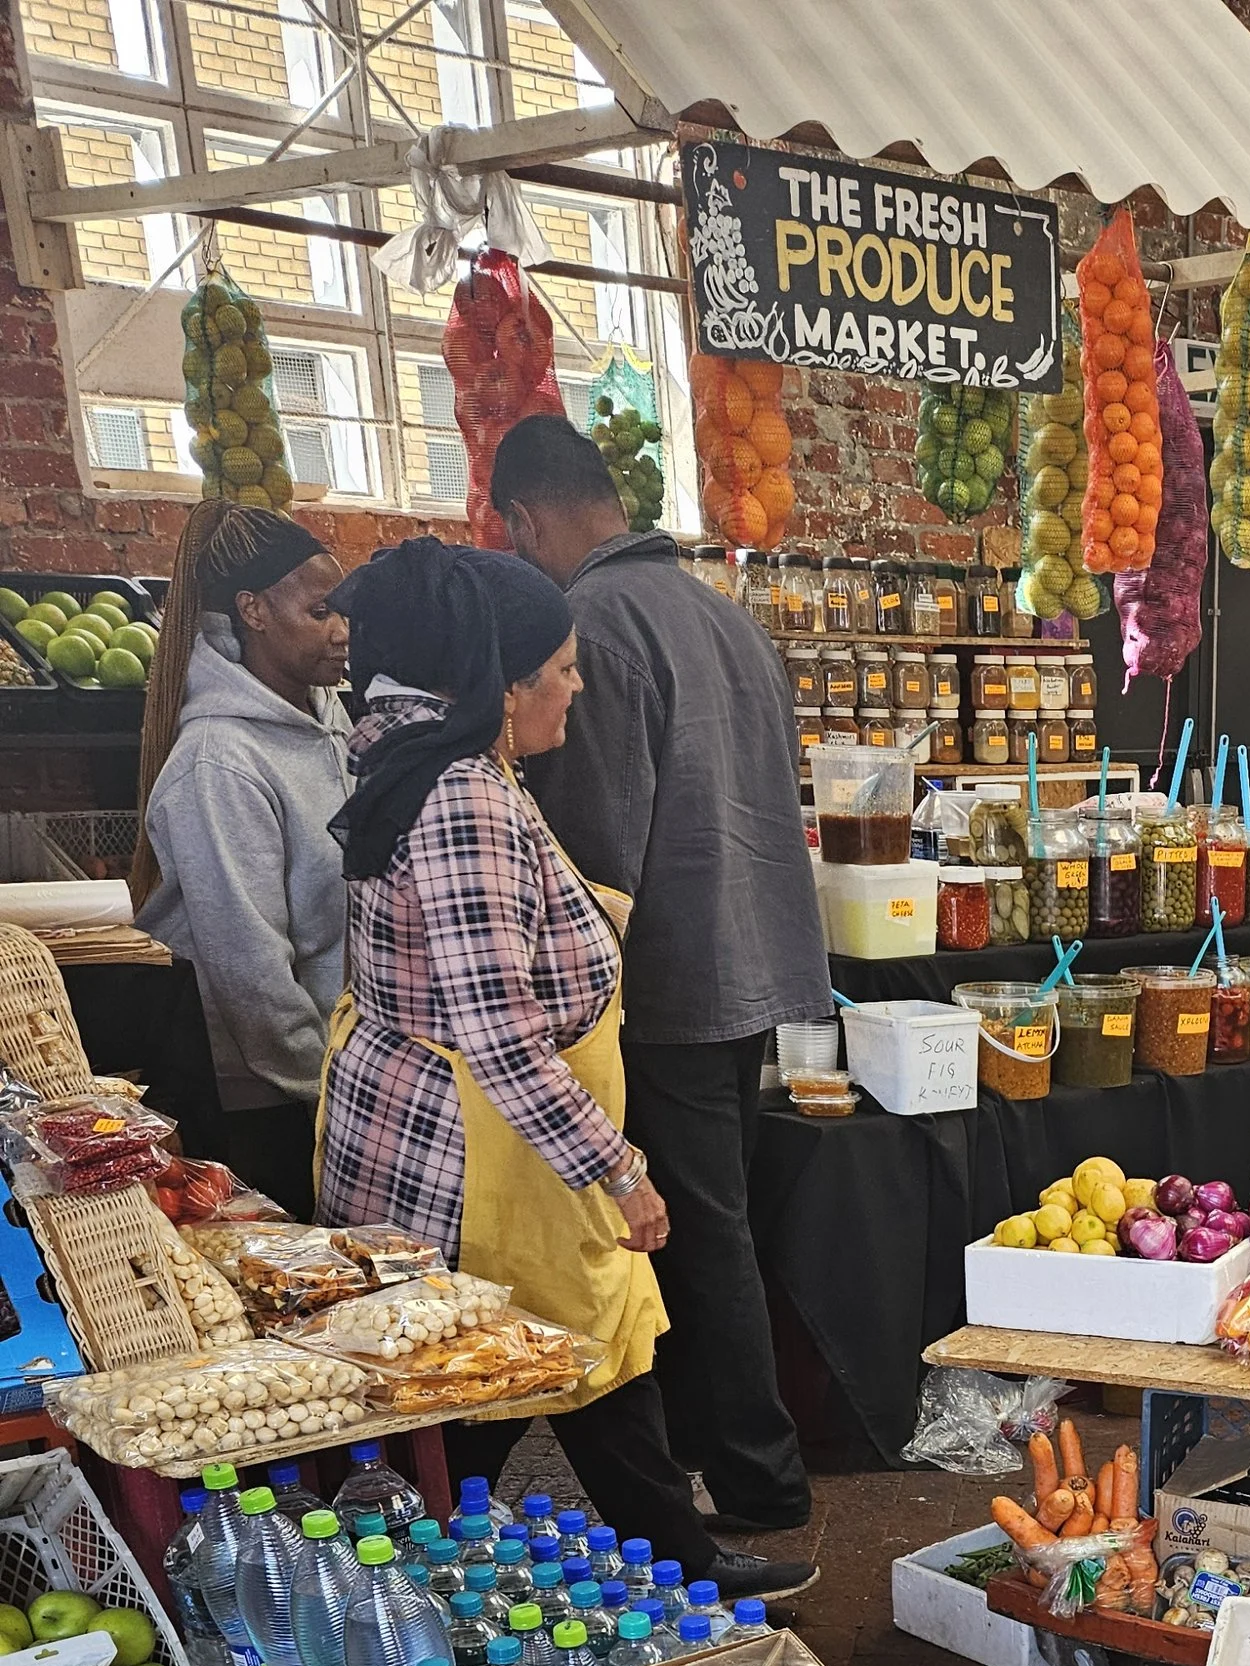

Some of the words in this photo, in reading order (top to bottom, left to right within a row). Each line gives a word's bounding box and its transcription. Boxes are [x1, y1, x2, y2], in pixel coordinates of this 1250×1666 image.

[778, 166, 862, 228] THE
[873, 182, 987, 249] FRESH
[775, 219, 1015, 323] PRODUCE
[918, 1033, 966, 1055] SOUR
[927, 1061, 956, 1081] FIG
[1164, 1530, 1211, 1547] Kalahari
